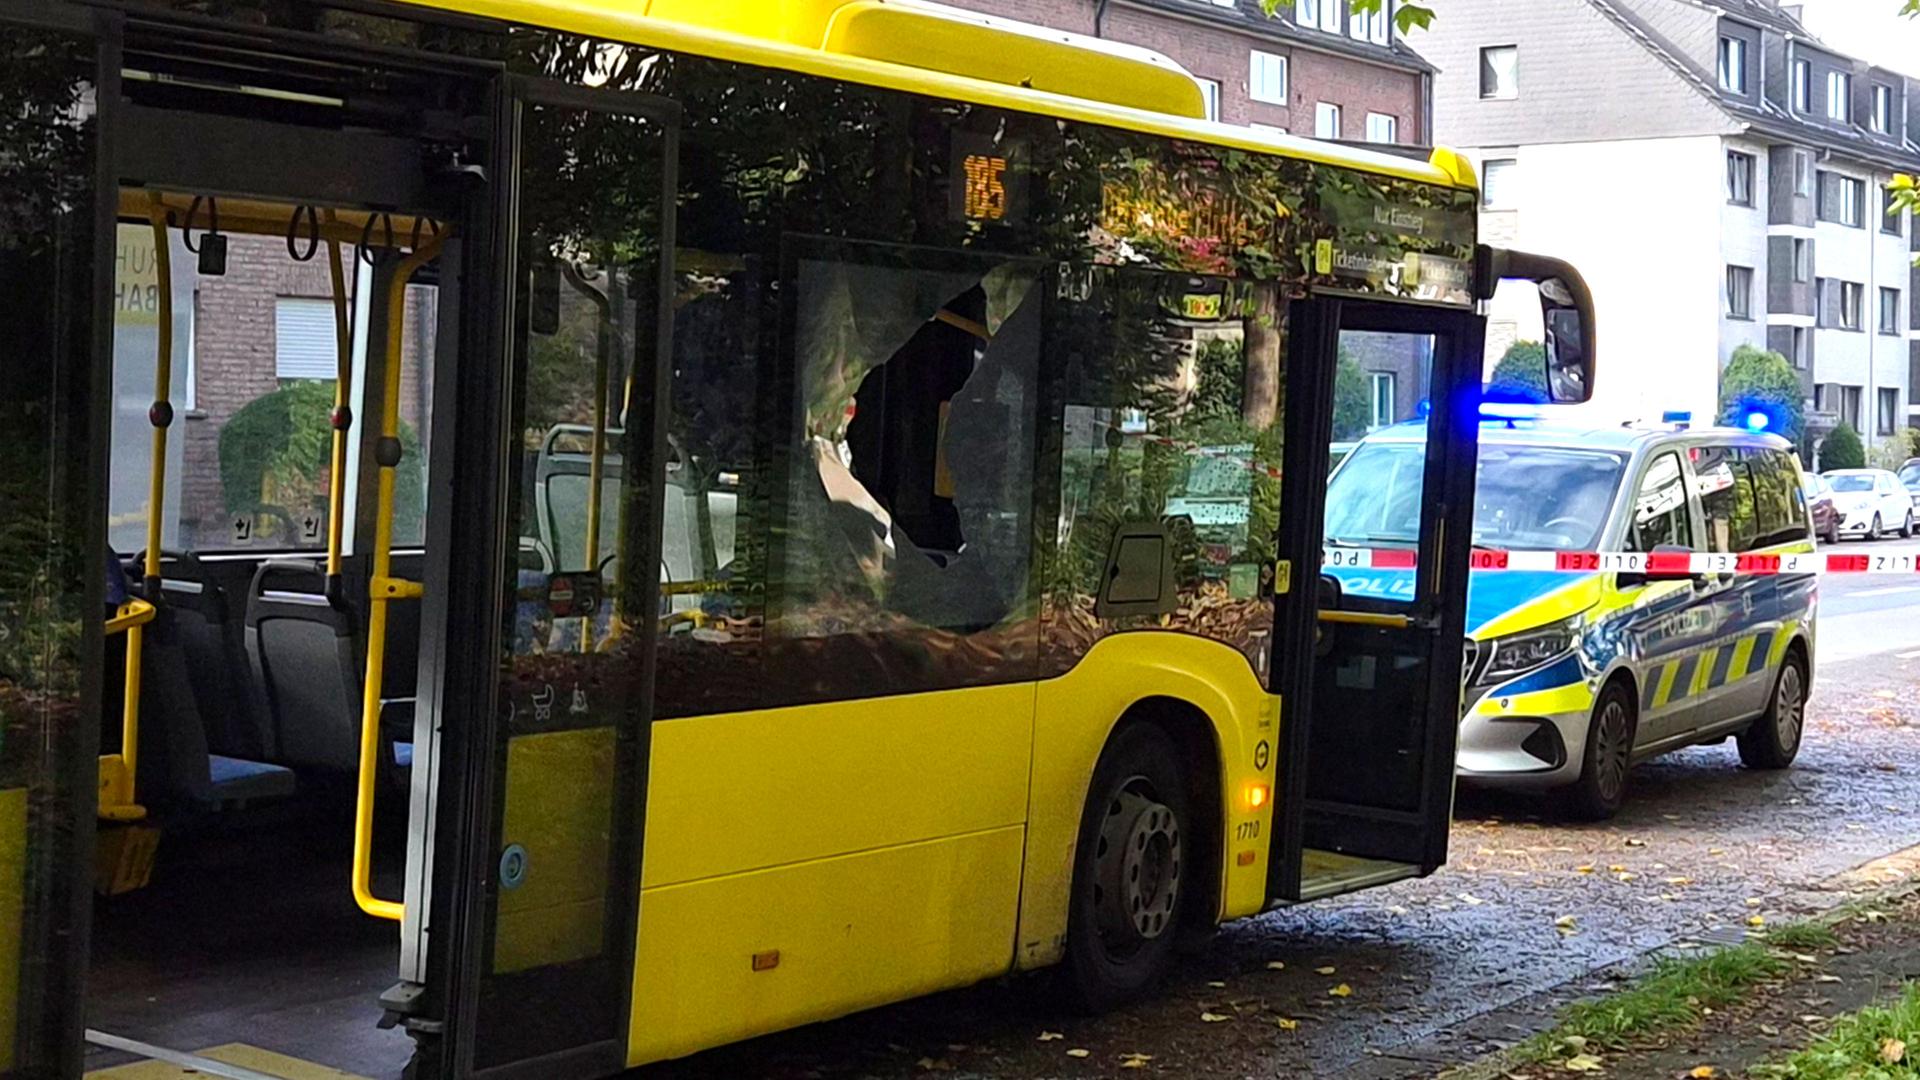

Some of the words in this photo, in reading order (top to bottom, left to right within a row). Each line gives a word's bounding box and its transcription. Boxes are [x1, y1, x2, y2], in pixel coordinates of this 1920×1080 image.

[1374, 205, 1390, 224] Nur
[1560, 553, 1654, 570] POLIZEI
[1707, 555, 1797, 571] POLIZEI
[1236, 820, 1260, 841] 1710
